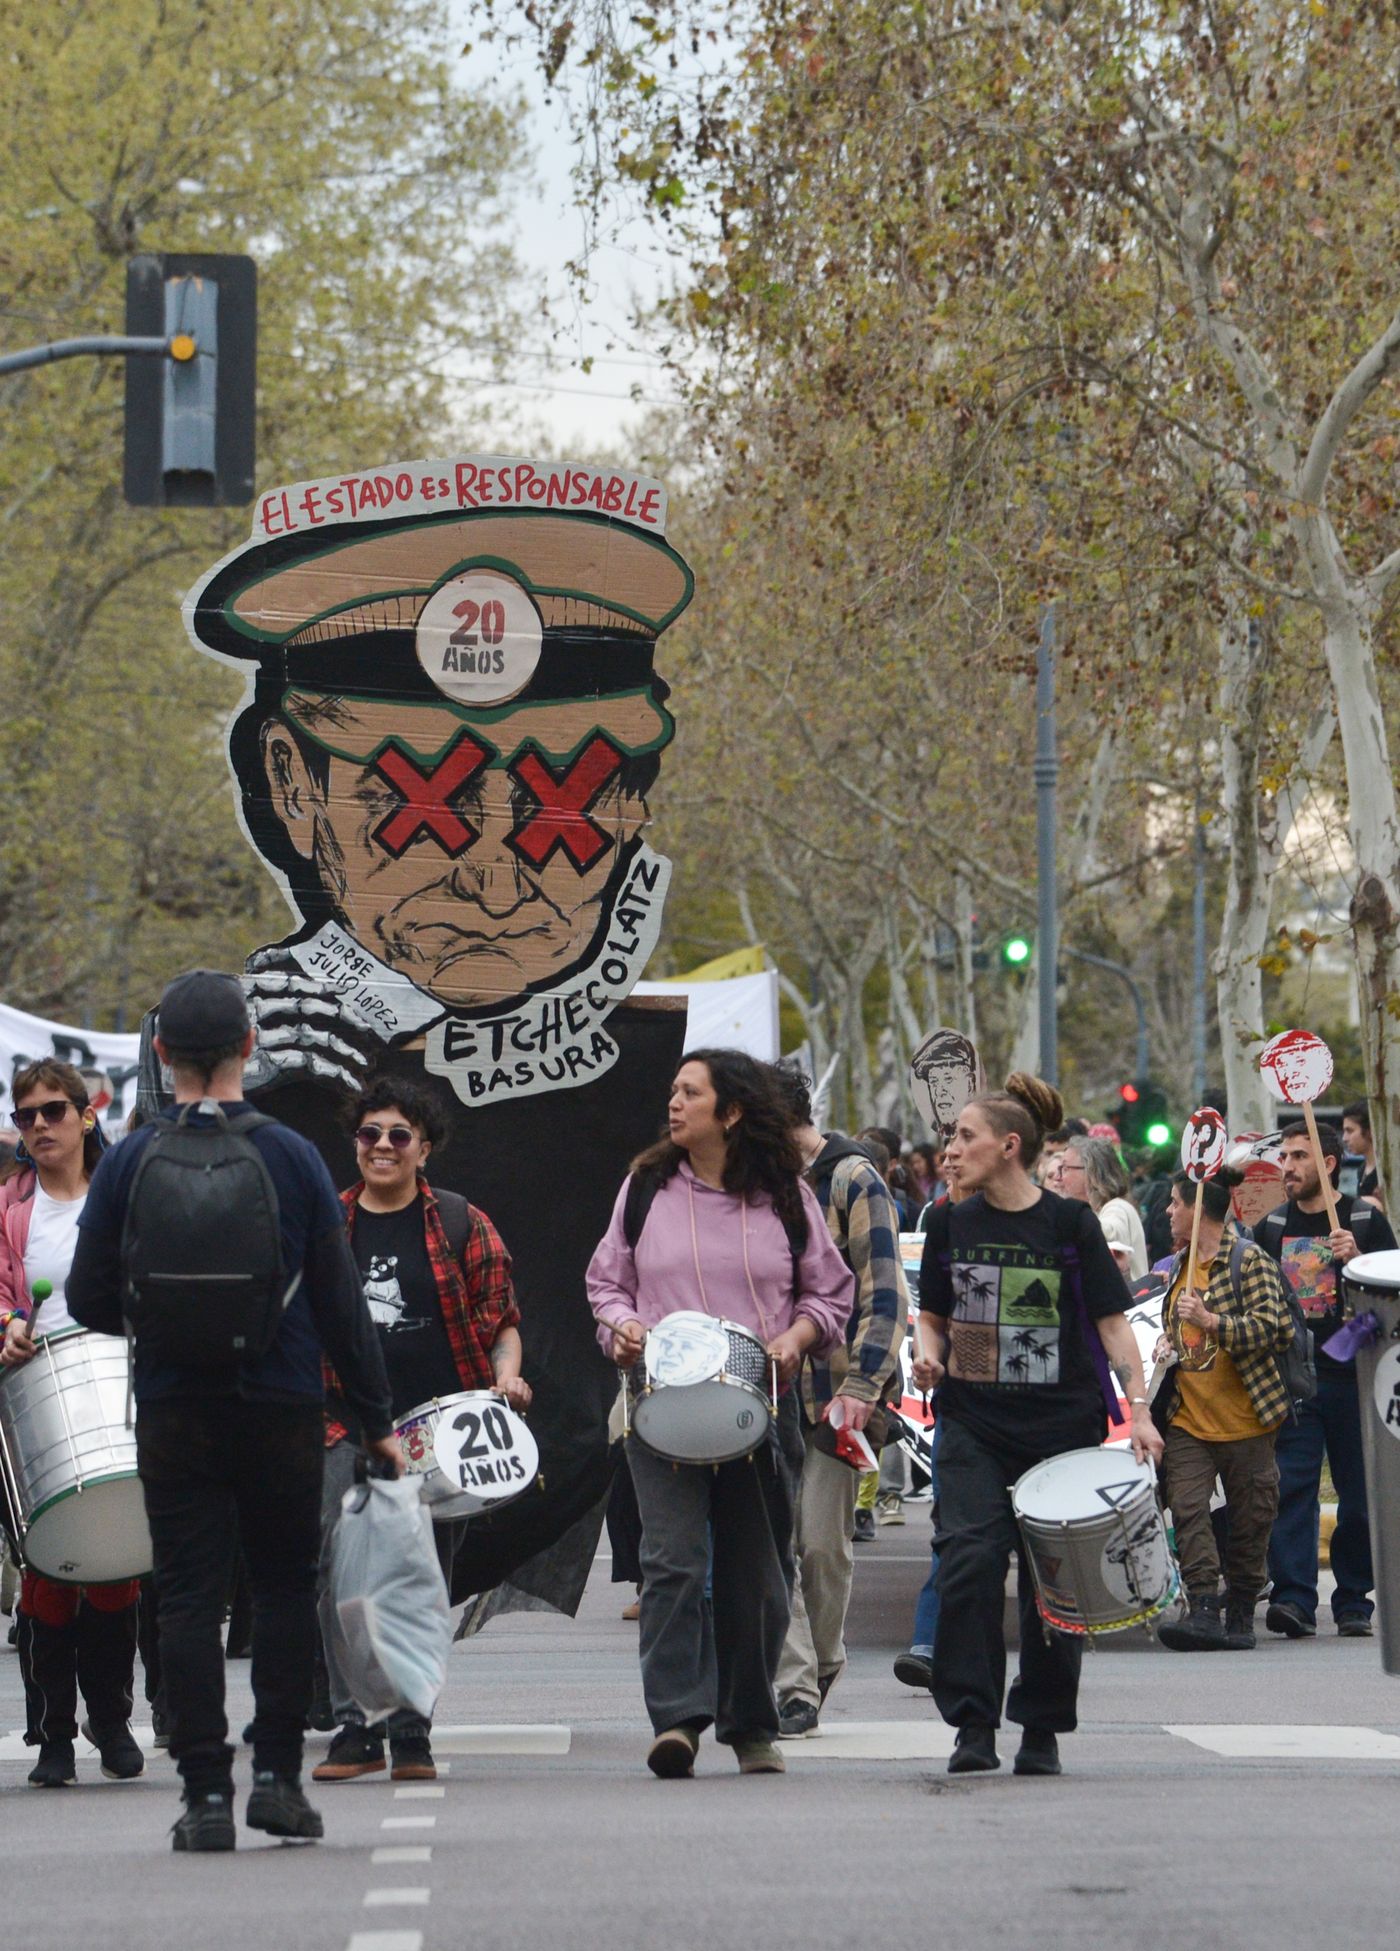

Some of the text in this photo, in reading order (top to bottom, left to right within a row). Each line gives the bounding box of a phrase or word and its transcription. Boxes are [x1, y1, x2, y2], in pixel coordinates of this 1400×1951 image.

[260, 463, 660, 535] EL ESTADO ES RESPONSABLE
[449, 599, 505, 646] 20
[441, 646, 505, 675] AÑOS
[320, 933, 375, 978] JORGE
[443, 858, 661, 1062] ETCHECOLATZ
[308, 951, 398, 1031] JULIO LÓPEZ
[467, 1031, 615, 1098] BASURA
[952, 1249, 1054, 1266] SURFING
[452, 1406, 514, 1460] 20
[459, 1456, 526, 1488] AÑOS
